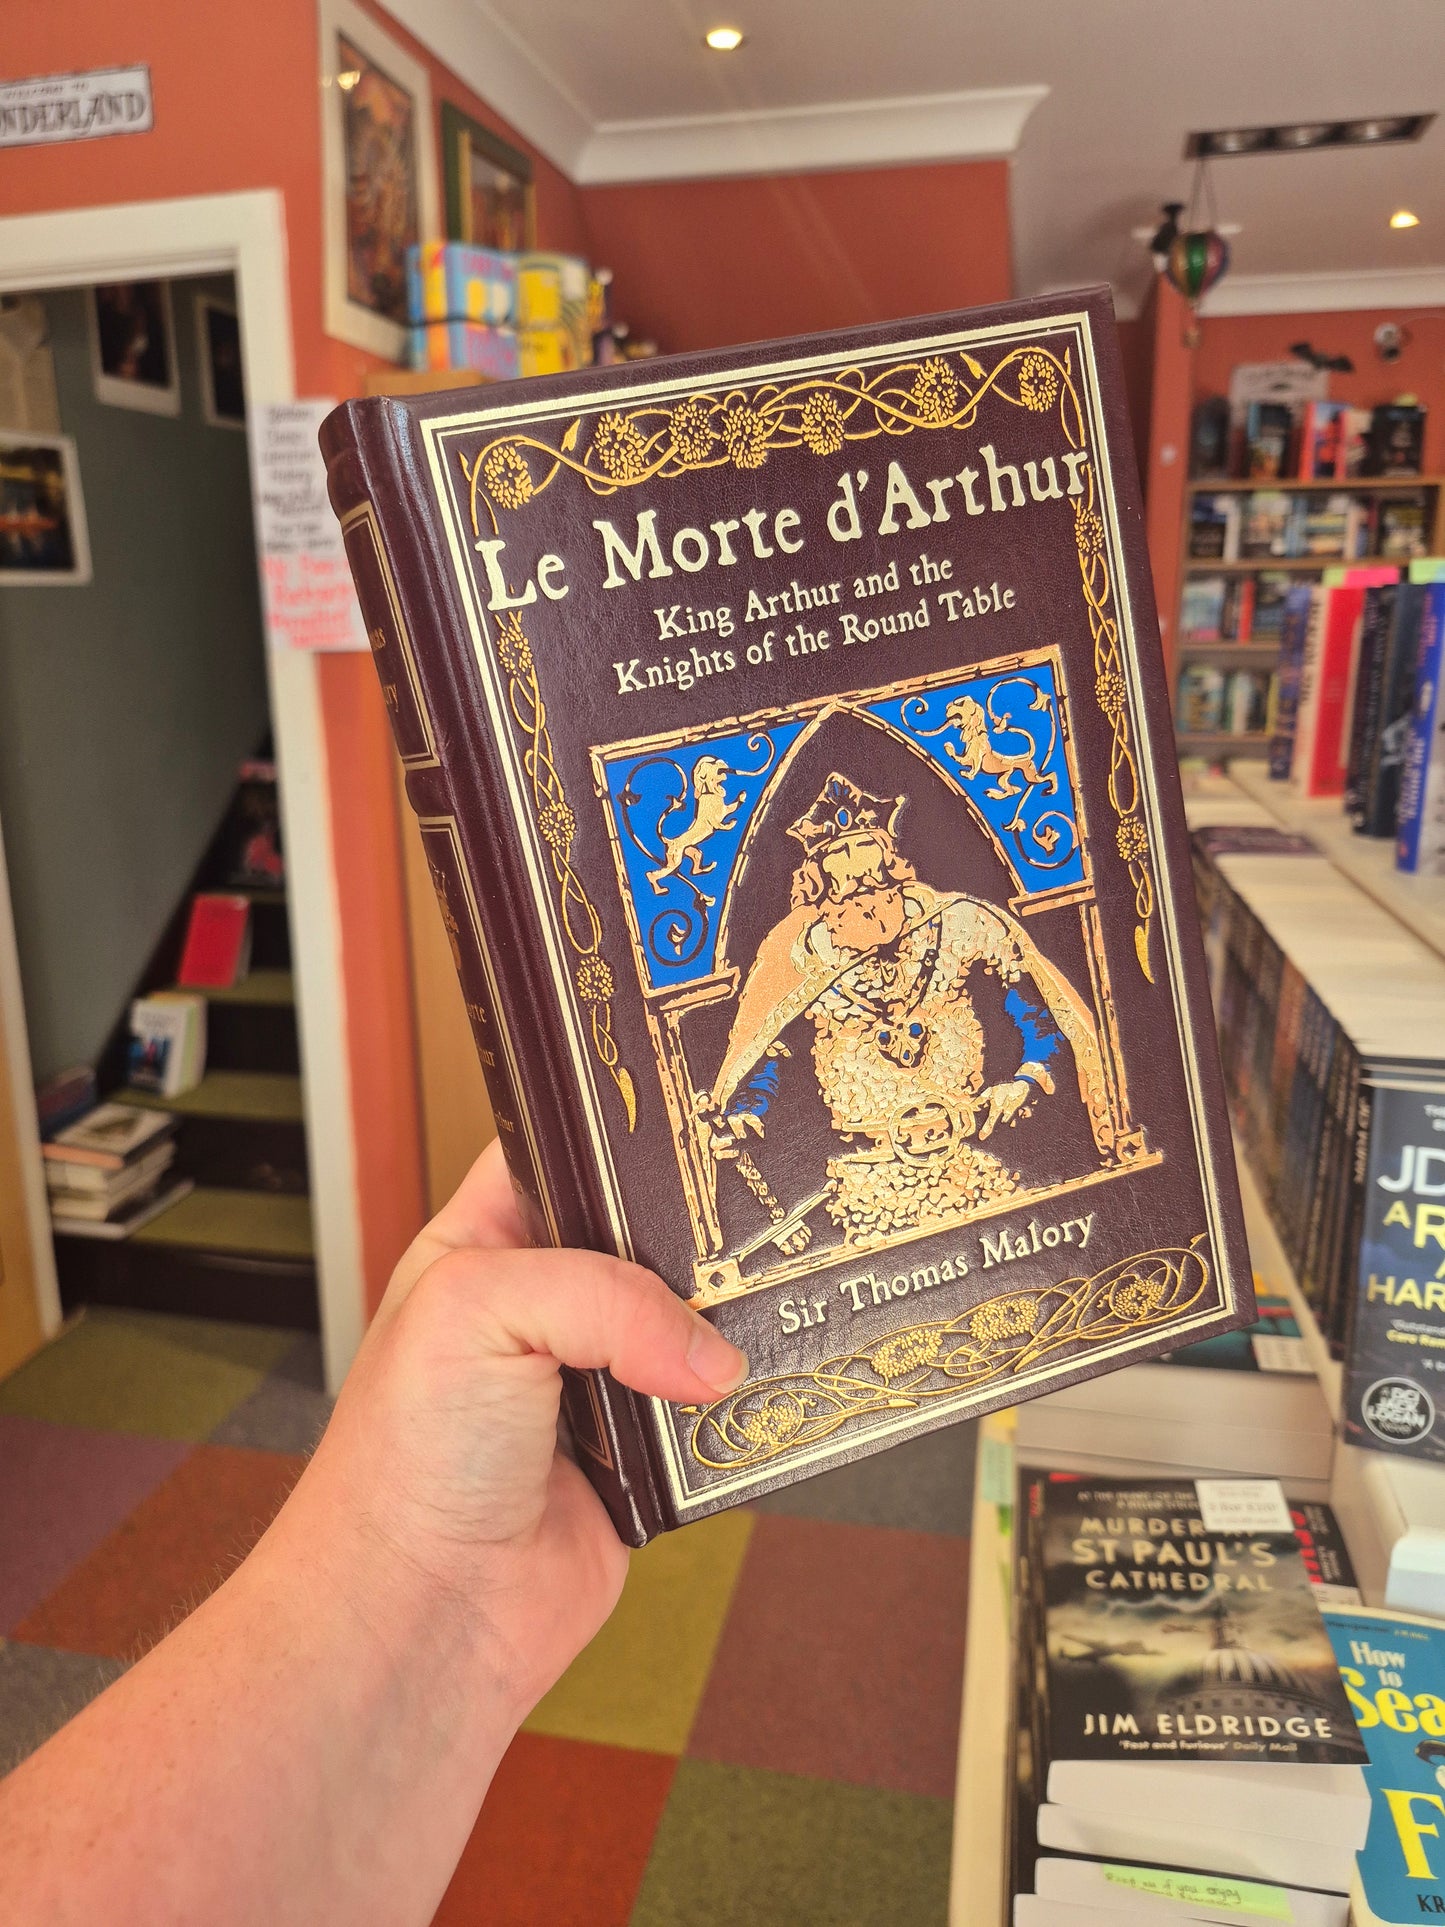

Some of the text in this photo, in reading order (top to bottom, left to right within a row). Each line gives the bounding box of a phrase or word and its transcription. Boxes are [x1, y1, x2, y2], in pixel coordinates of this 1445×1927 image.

[475, 444, 1088, 611] Le Morte d'Arthur
[653, 554, 953, 640] King Arthur and the
[613, 582, 1016, 694] Knights of the Round Table
[1377, 1144, 1445, 1197] JD
[1382, 1200, 1412, 1229] A
[778, 1212, 1095, 1335] Sir Thomas Malory
[1080, 1517, 1207, 1538] MURDER
[1071, 1538, 1277, 1568] ST PAUL'S
[1085, 1570, 1273, 1593] CATHEDRAL
[1349, 1640, 1405, 1669] How
[1378, 1668, 1403, 1688] to
[1083, 1713, 1333, 1739] JIM ELDRIDGE
[1152, 1740, 1178, 1750] and
[1233, 1741, 1266, 1753] Daily
[1270, 1742, 1298, 1752] Mail
[1380, 1788, 1445, 1880] F
